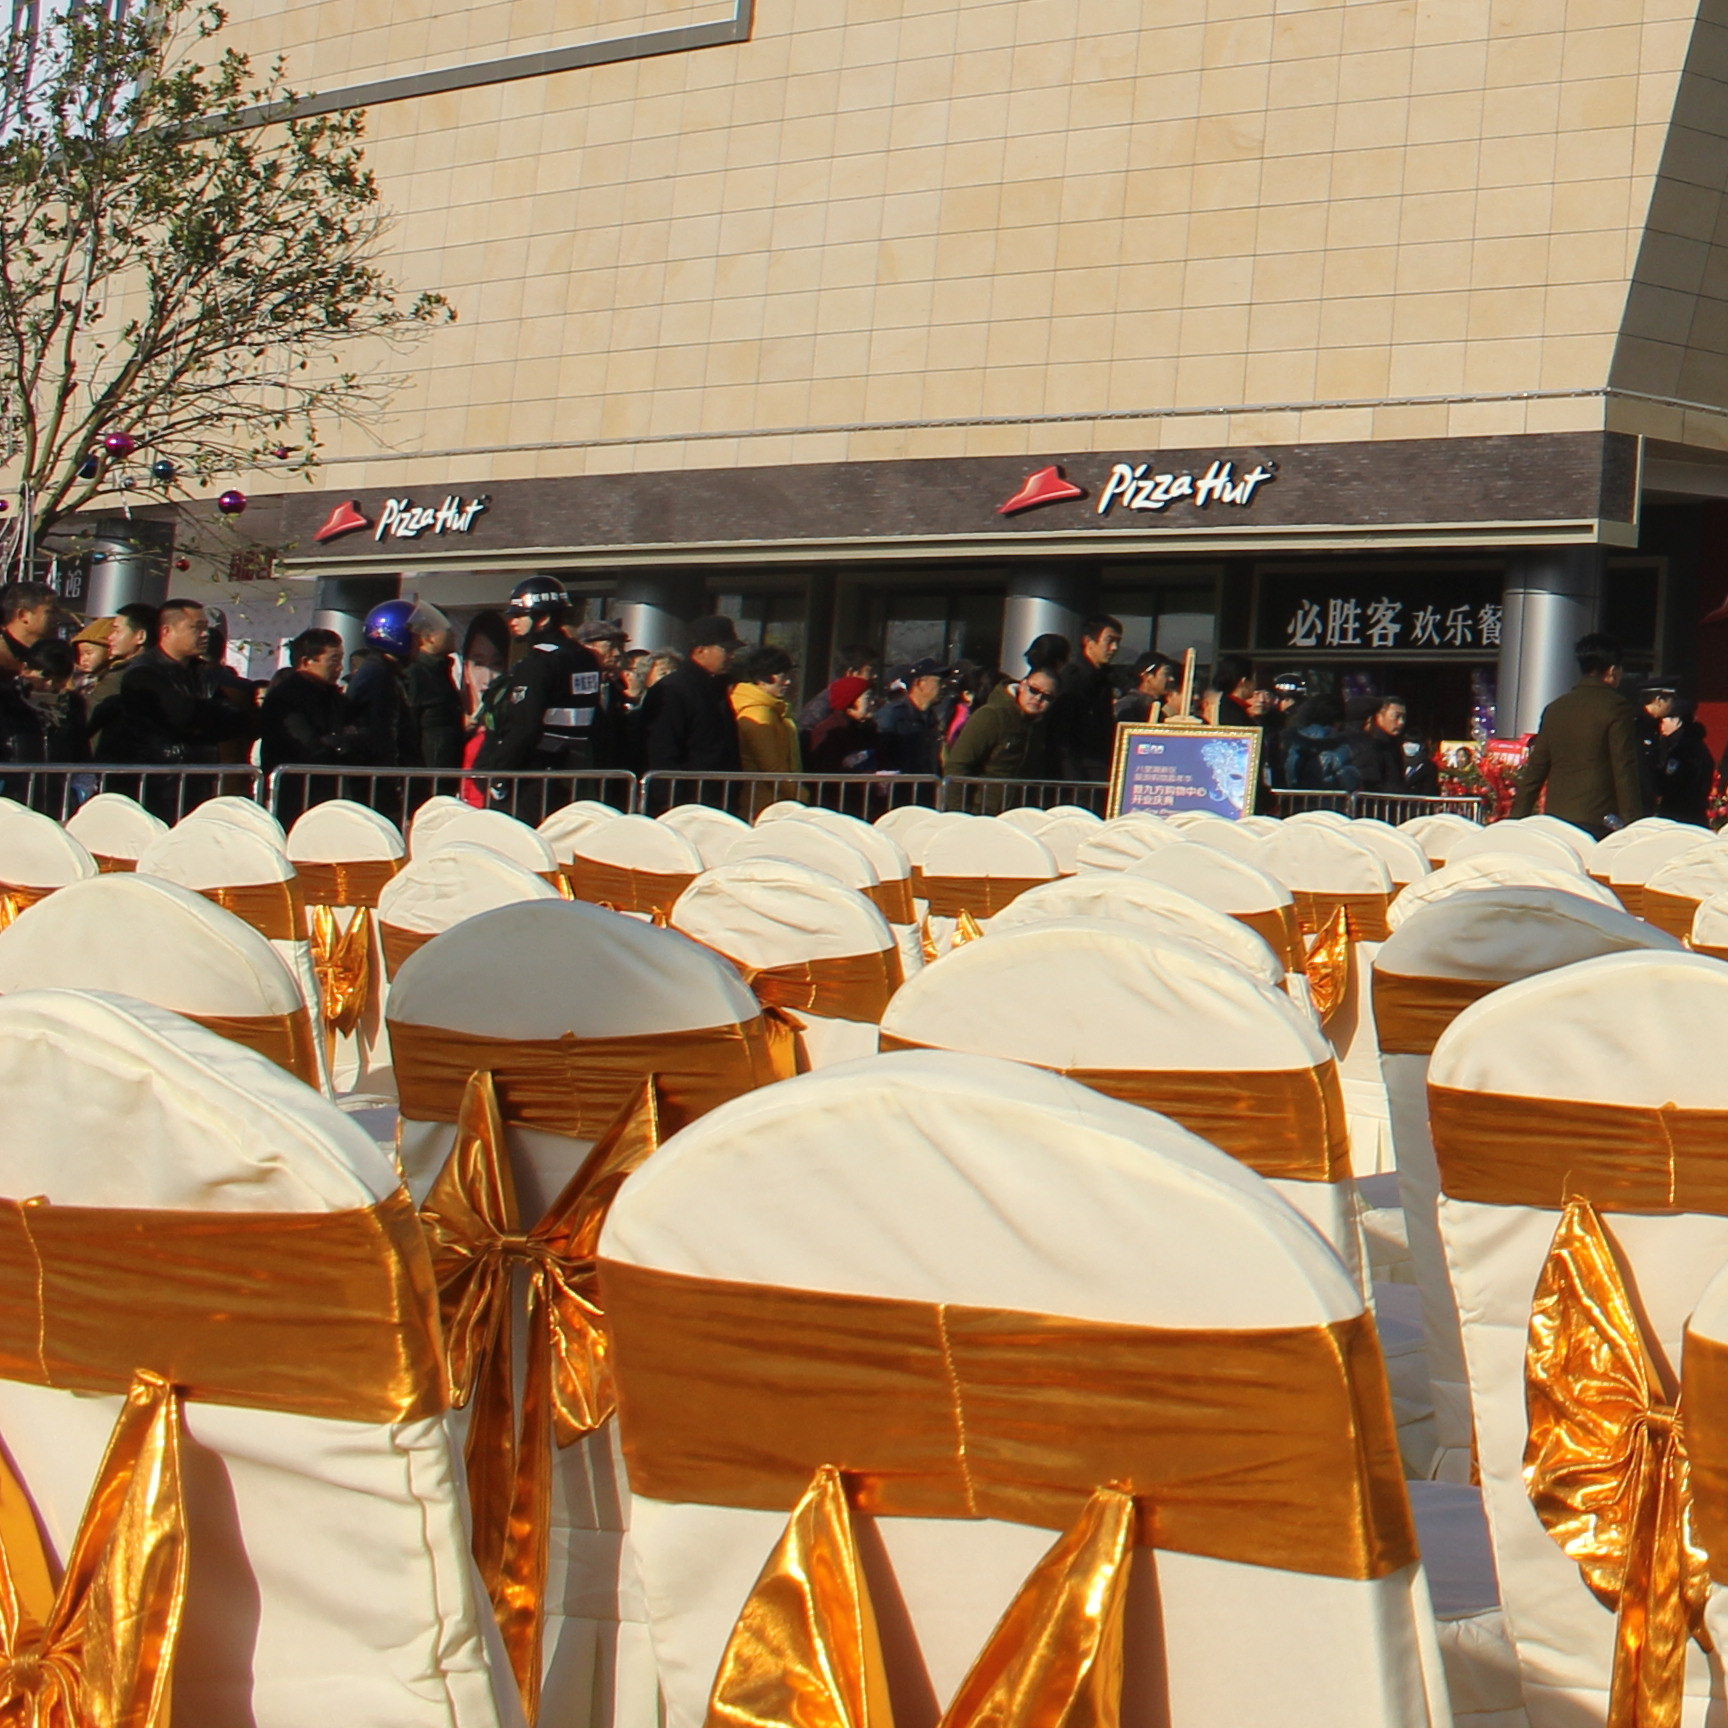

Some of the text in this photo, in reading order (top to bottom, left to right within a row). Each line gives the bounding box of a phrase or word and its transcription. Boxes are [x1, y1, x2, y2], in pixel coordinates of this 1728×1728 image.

[1096, 459, 1272, 515] Pizza Hut
[374, 494, 485, 542] Pizza Hut
[1286, 595, 1403, 648] 必胜客
